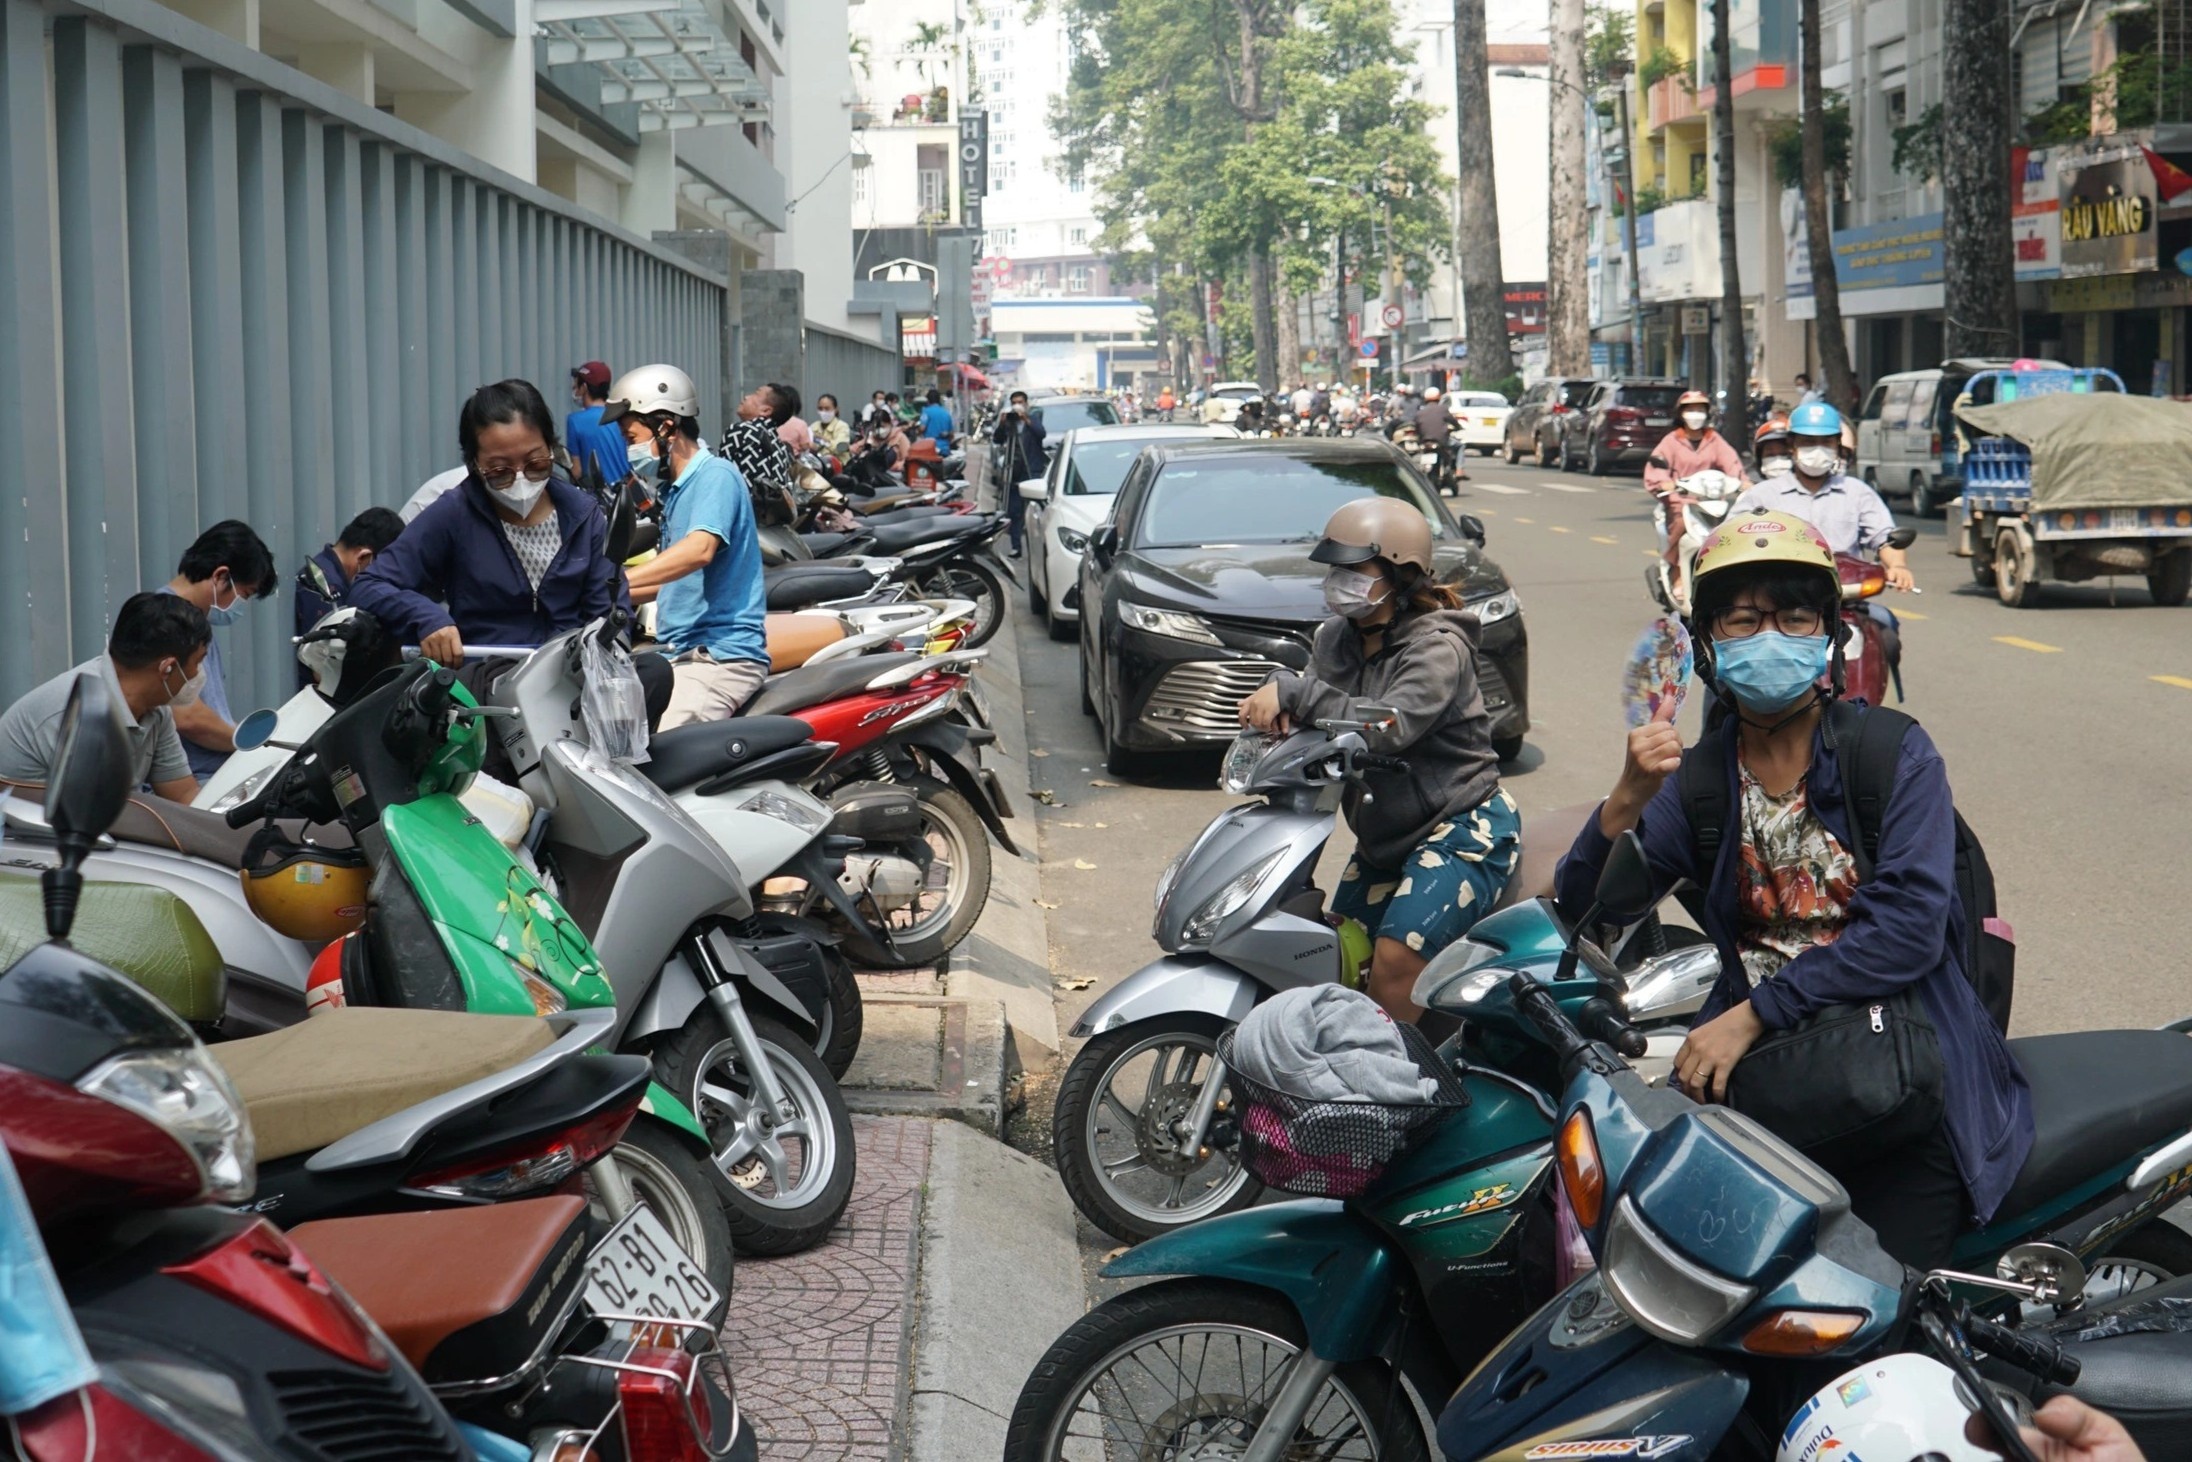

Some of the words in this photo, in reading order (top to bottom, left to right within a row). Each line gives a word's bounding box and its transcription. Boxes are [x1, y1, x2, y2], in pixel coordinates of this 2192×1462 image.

[961, 120, 980, 229] HOTEL
[2095, 184, 2143, 237] VÀNG
[1504, 290, 1547, 302] MERC
[1293, 943, 1334, 960] HONDA
[1398, 1189, 1518, 1226] Future
[591, 1222, 667, 1310] 62-B1
[1447, 1261, 1509, 1271] U-Functions
[1524, 1439, 1640, 1460] SIRIUS
